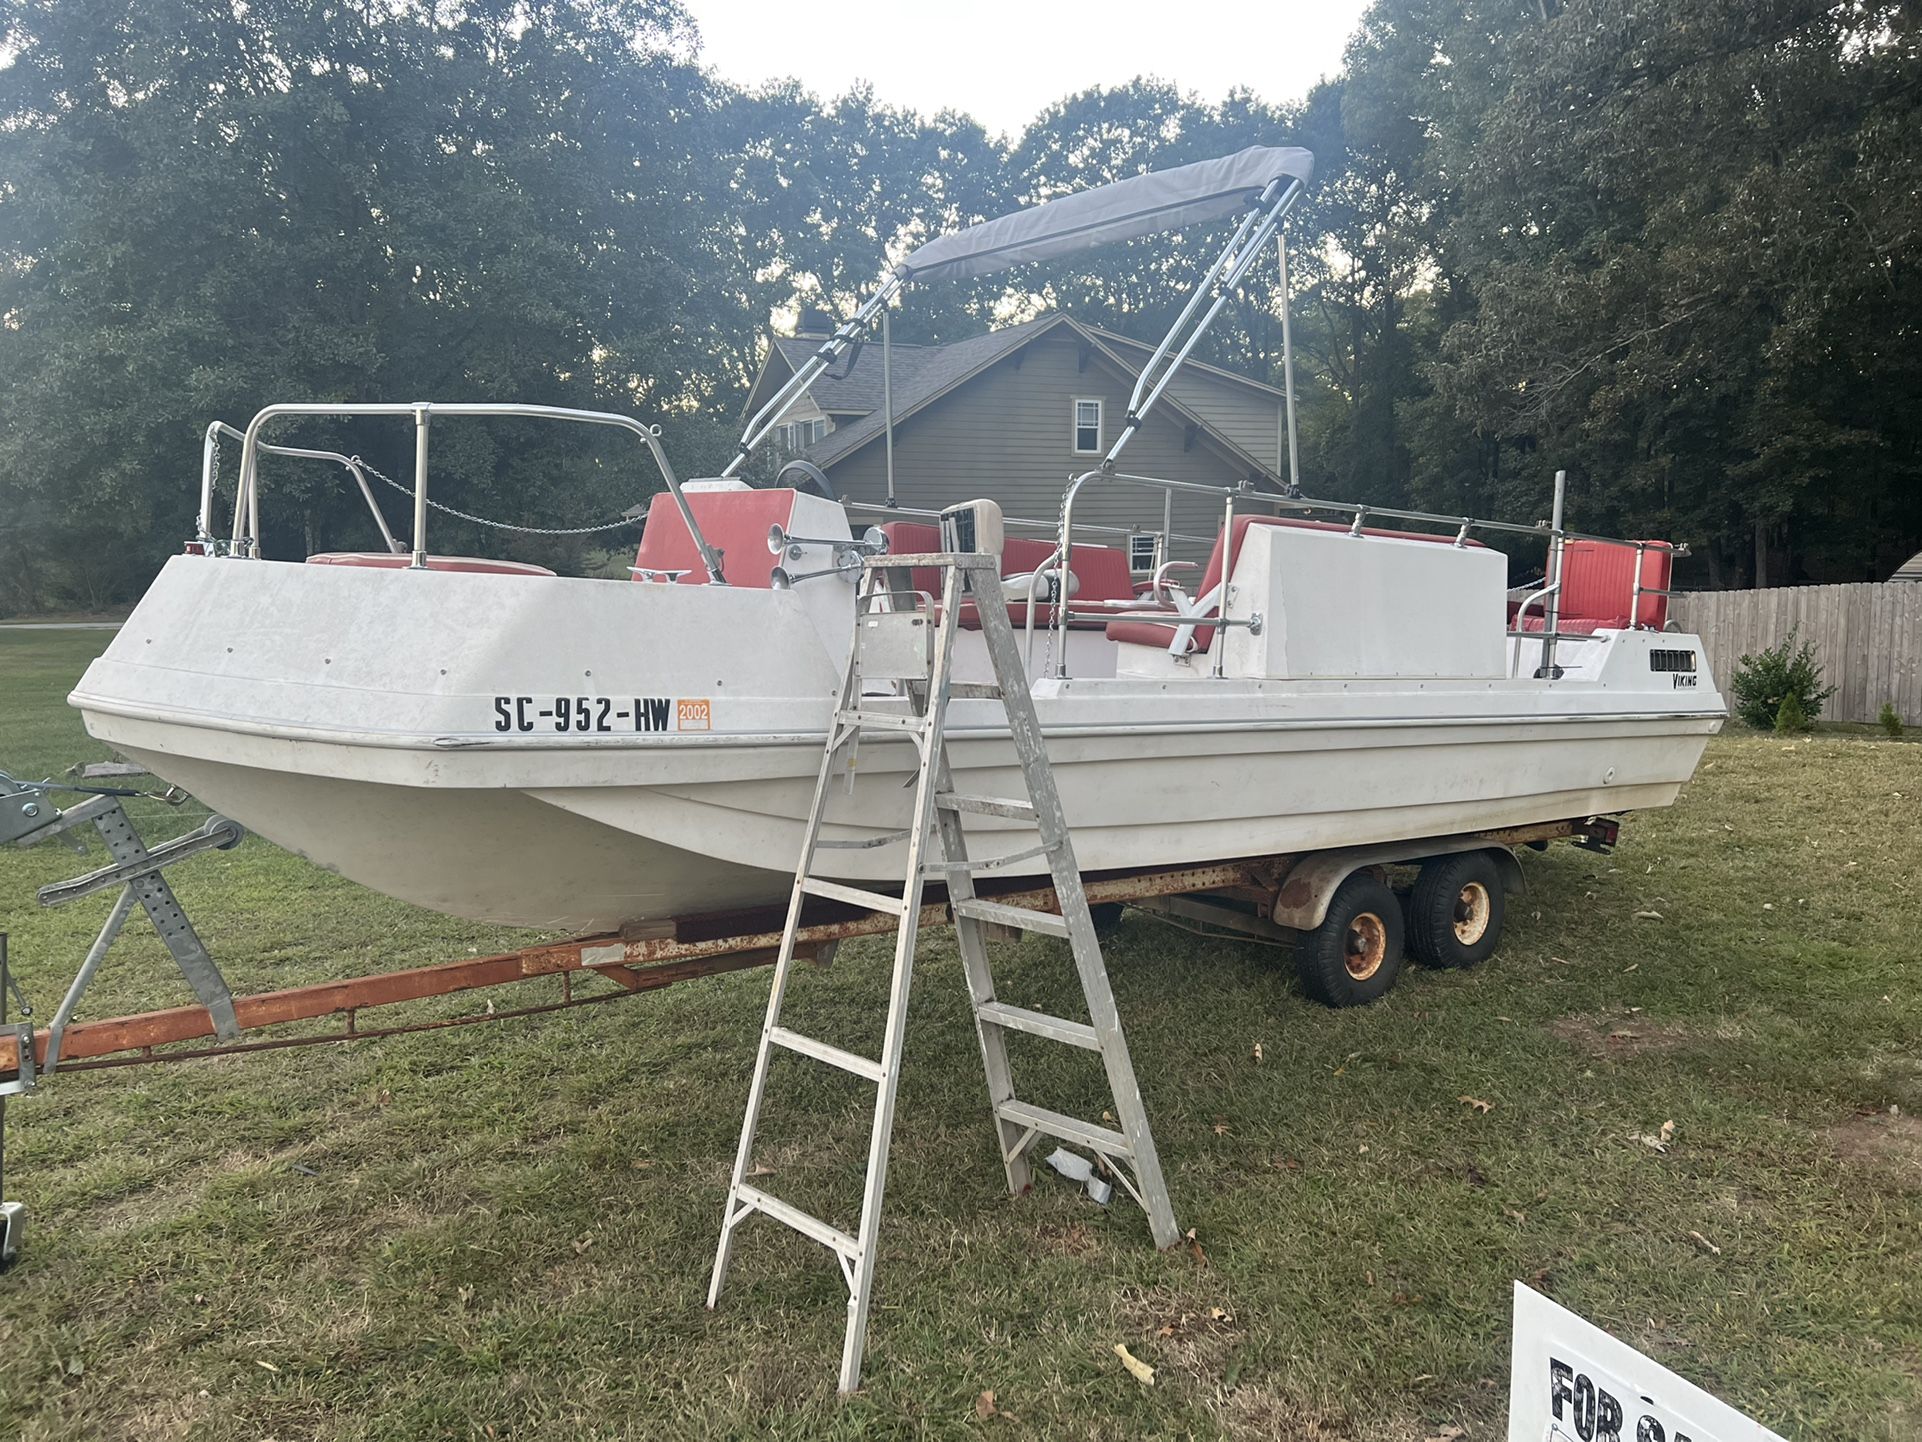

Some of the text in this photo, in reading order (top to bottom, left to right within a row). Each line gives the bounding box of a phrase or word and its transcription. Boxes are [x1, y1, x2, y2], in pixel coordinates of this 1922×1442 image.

[495, 697, 671, 732] SC-952-HW
[679, 704, 708, 719] 2002
[1550, 1356, 1623, 1442] FOR
